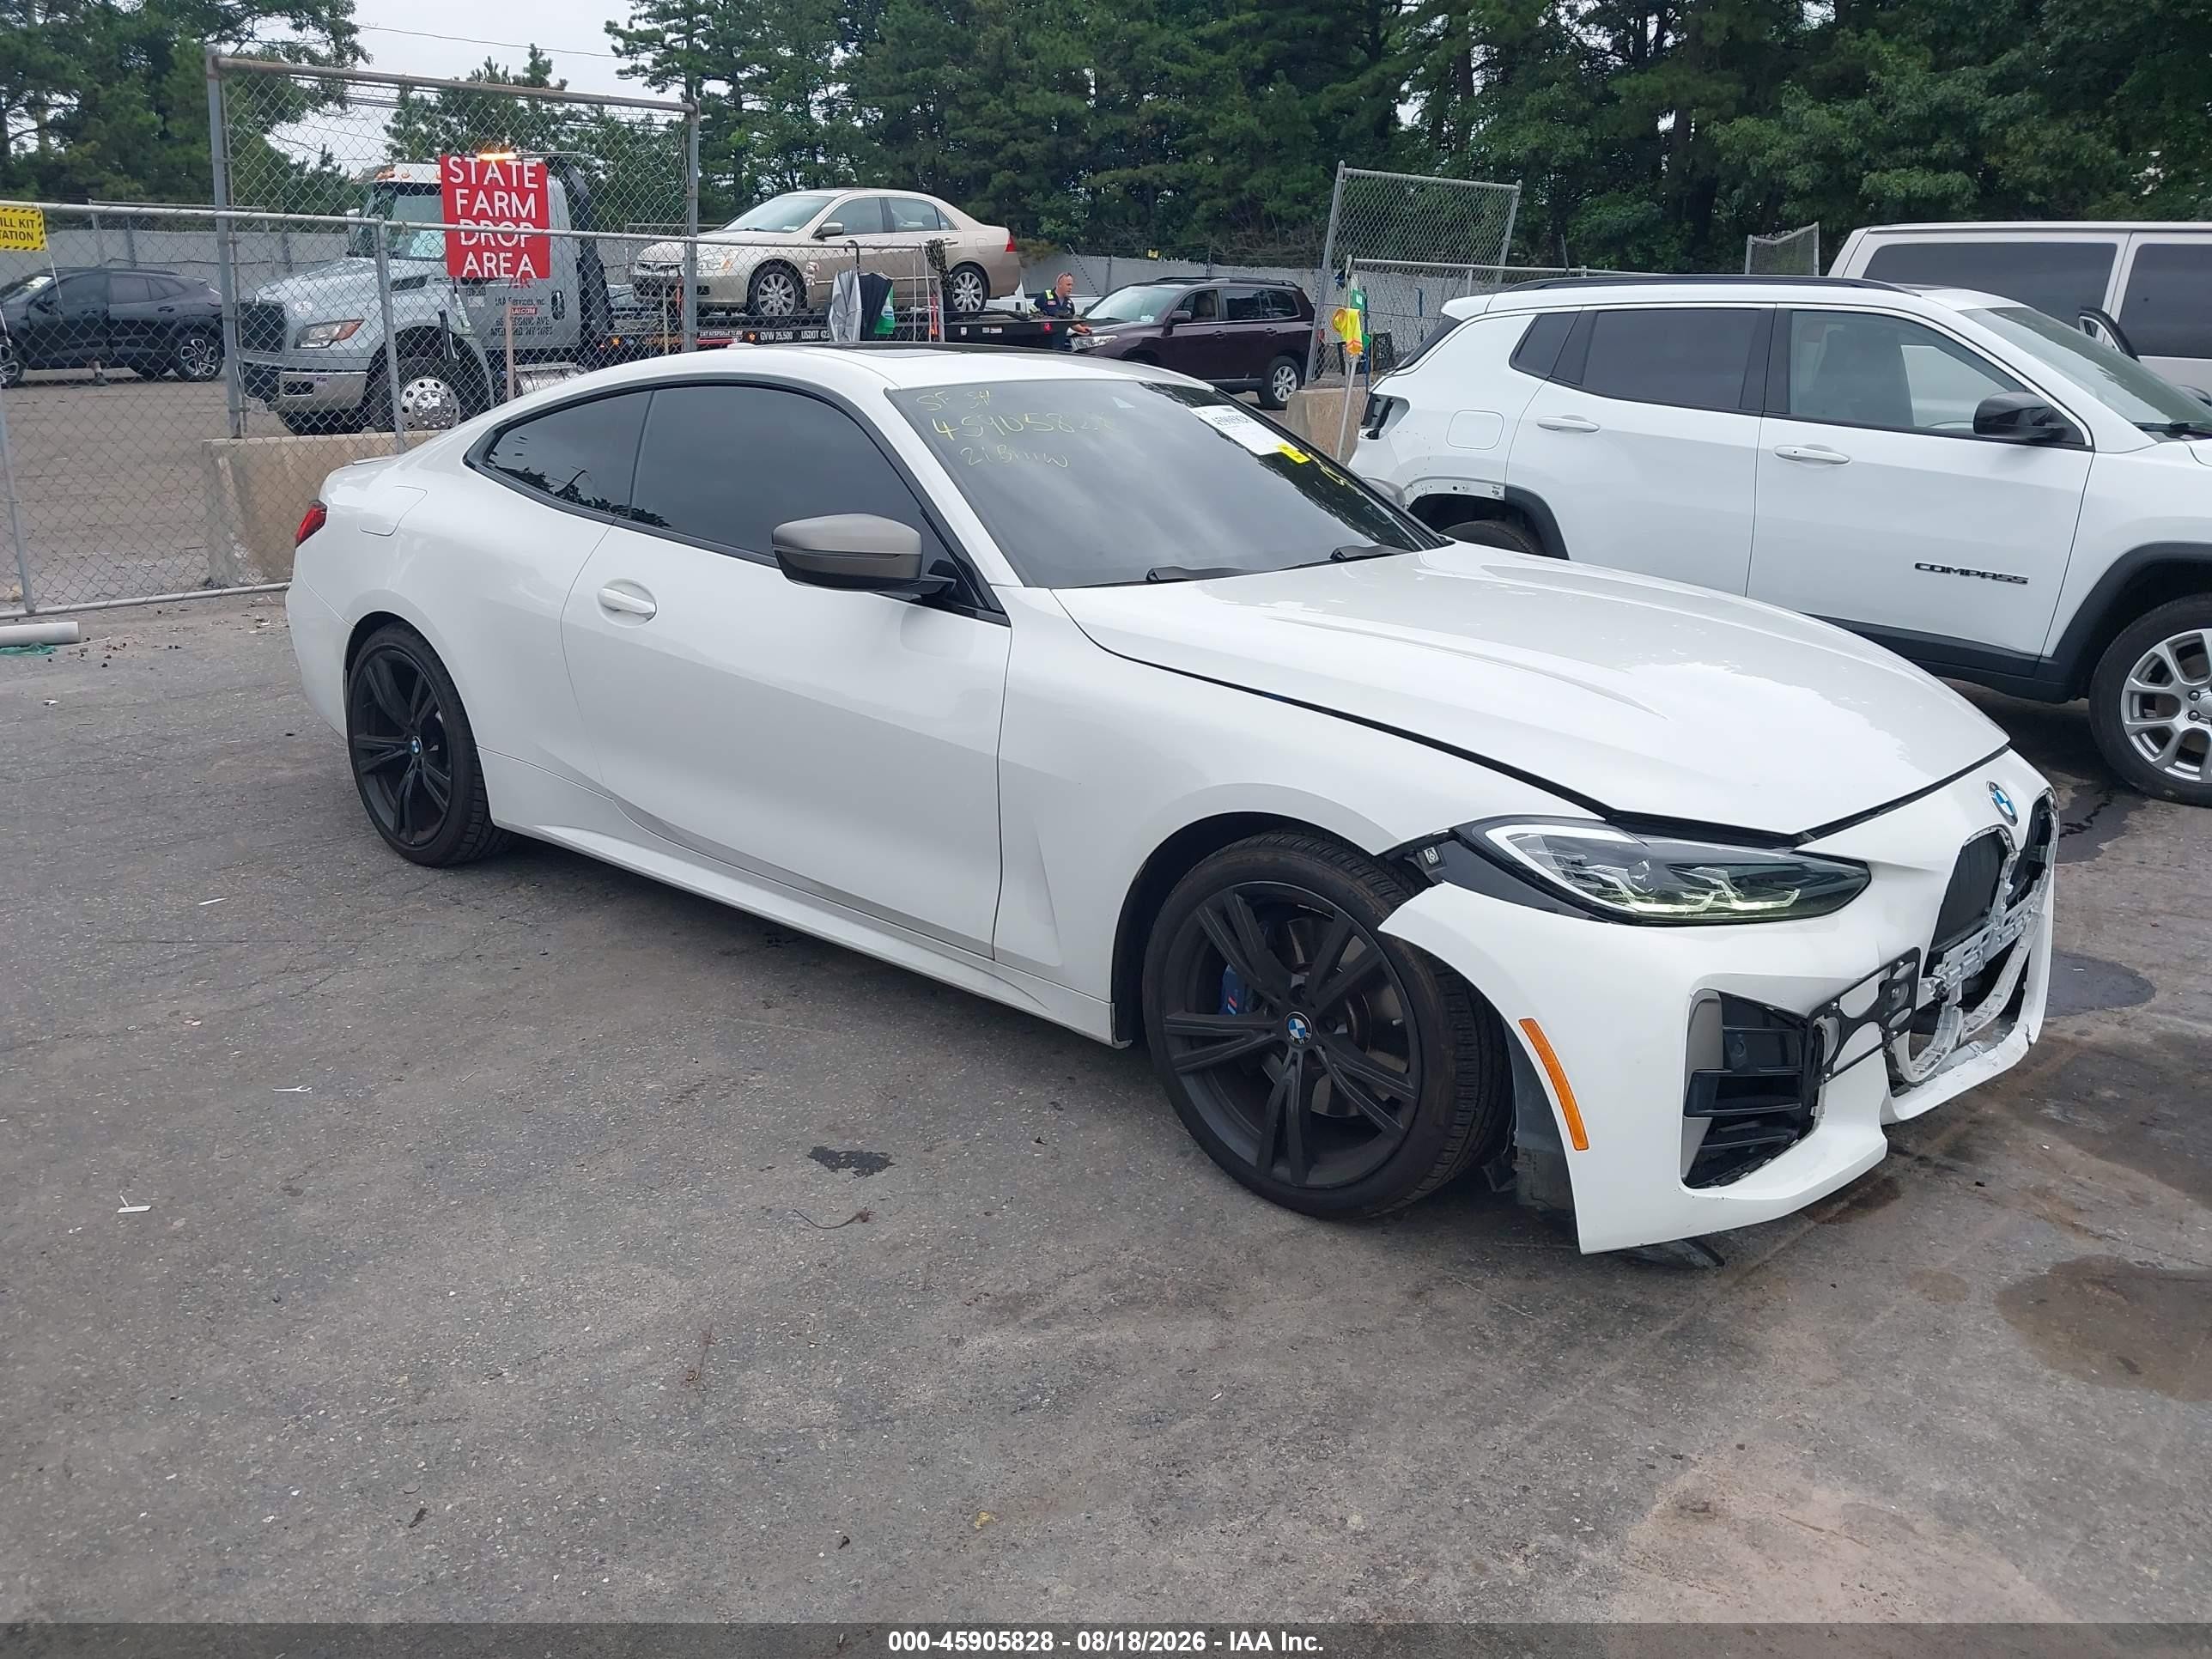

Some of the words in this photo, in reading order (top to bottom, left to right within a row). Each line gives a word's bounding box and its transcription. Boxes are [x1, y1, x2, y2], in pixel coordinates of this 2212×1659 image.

[448, 155, 538, 189] STATE
[455, 188, 537, 219] FARM
[0, 230, 34, 240] ATION
[19, 219, 35, 228] KIT
[459, 219, 534, 248] DROP
[461, 251, 537, 279] AREA
[760, 331, 775, 341] GVW
[775, 331, 793, 340] 25,500
[801, 330, 819, 339] USDOT
[1914, 562, 2029, 585] COMPASS
